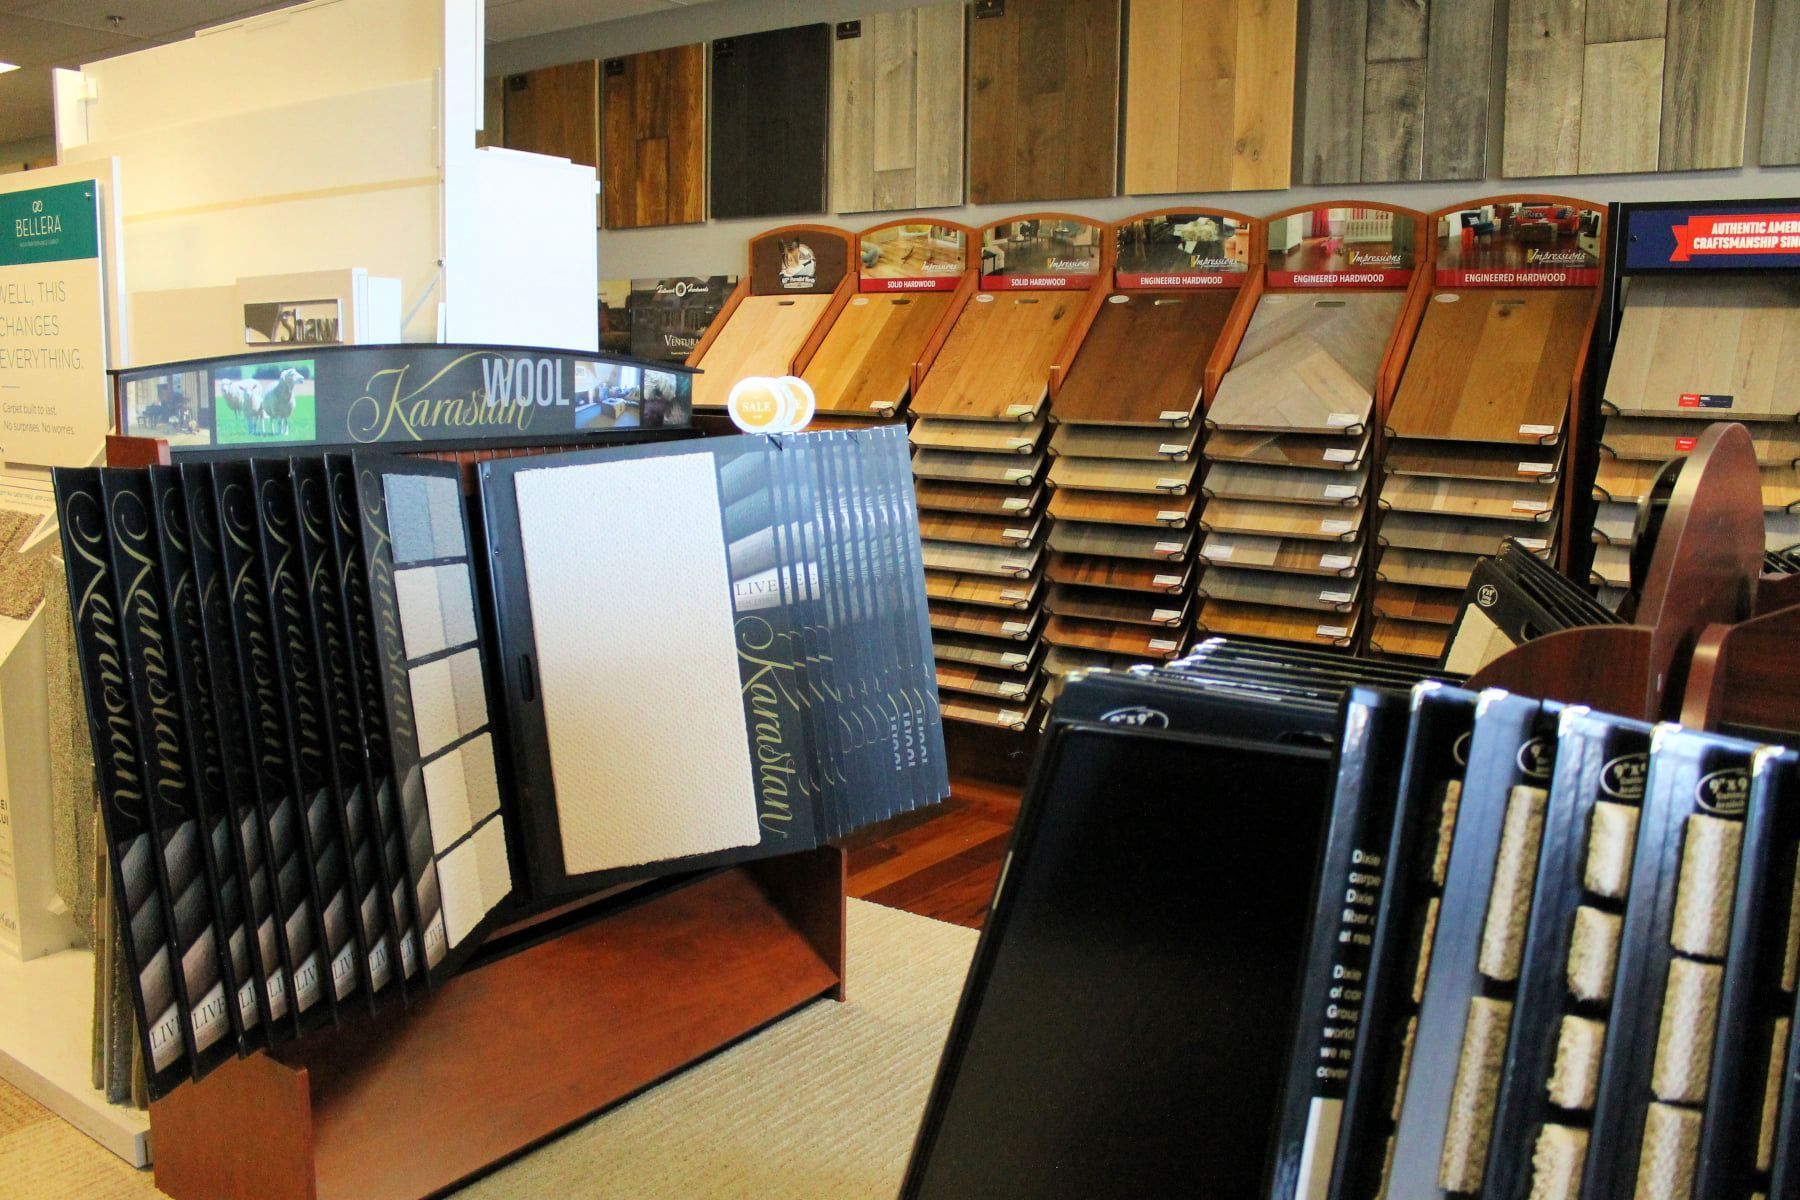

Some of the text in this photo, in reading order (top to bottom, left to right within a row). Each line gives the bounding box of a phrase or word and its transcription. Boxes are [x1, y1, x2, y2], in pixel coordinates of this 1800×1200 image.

[16, 215, 62, 238] BELLERA
[1711, 221, 1767, 235] AUTHENTIC
[1693, 235, 1800, 249] CRAFTSMANSHIP SIN
[1194, 255, 1238, 270] Impressions
[1352, 251, 1402, 265] Impressions
[1531, 248, 1587, 264] Impressions
[887, 280, 936, 289] SOLID HARDWOOD
[1011, 277, 1066, 287] SOLID HARDWOOD
[1140, 276, 1223, 285] ENGINEERED HARDWOOD
[1293, 273, 1385, 283] ENGINEERED HARDWOOD
[1464, 273, 1566, 283] ENGINEERED HARDWOOD
[37, 280, 66, 303] THIS
[0, 315, 60, 337] CHANGES
[280, 308, 338, 343] Shaw
[0, 348, 84, 370] EVERYTHING.
[482, 358, 571, 408] WOOL
[347, 350, 536, 444] Karastan
[3, 402, 23, 415] Carpet
[38, 405, 45, 415] to
[742, 400, 771, 412] SALE
[3, 420, 13, 431] No
[42, 422, 51, 433] No
[736, 577, 778, 596] LIVE
[734, 615, 800, 839] Karastan
[369, 947, 386, 973] LIV
[294, 965, 316, 993] LIV
